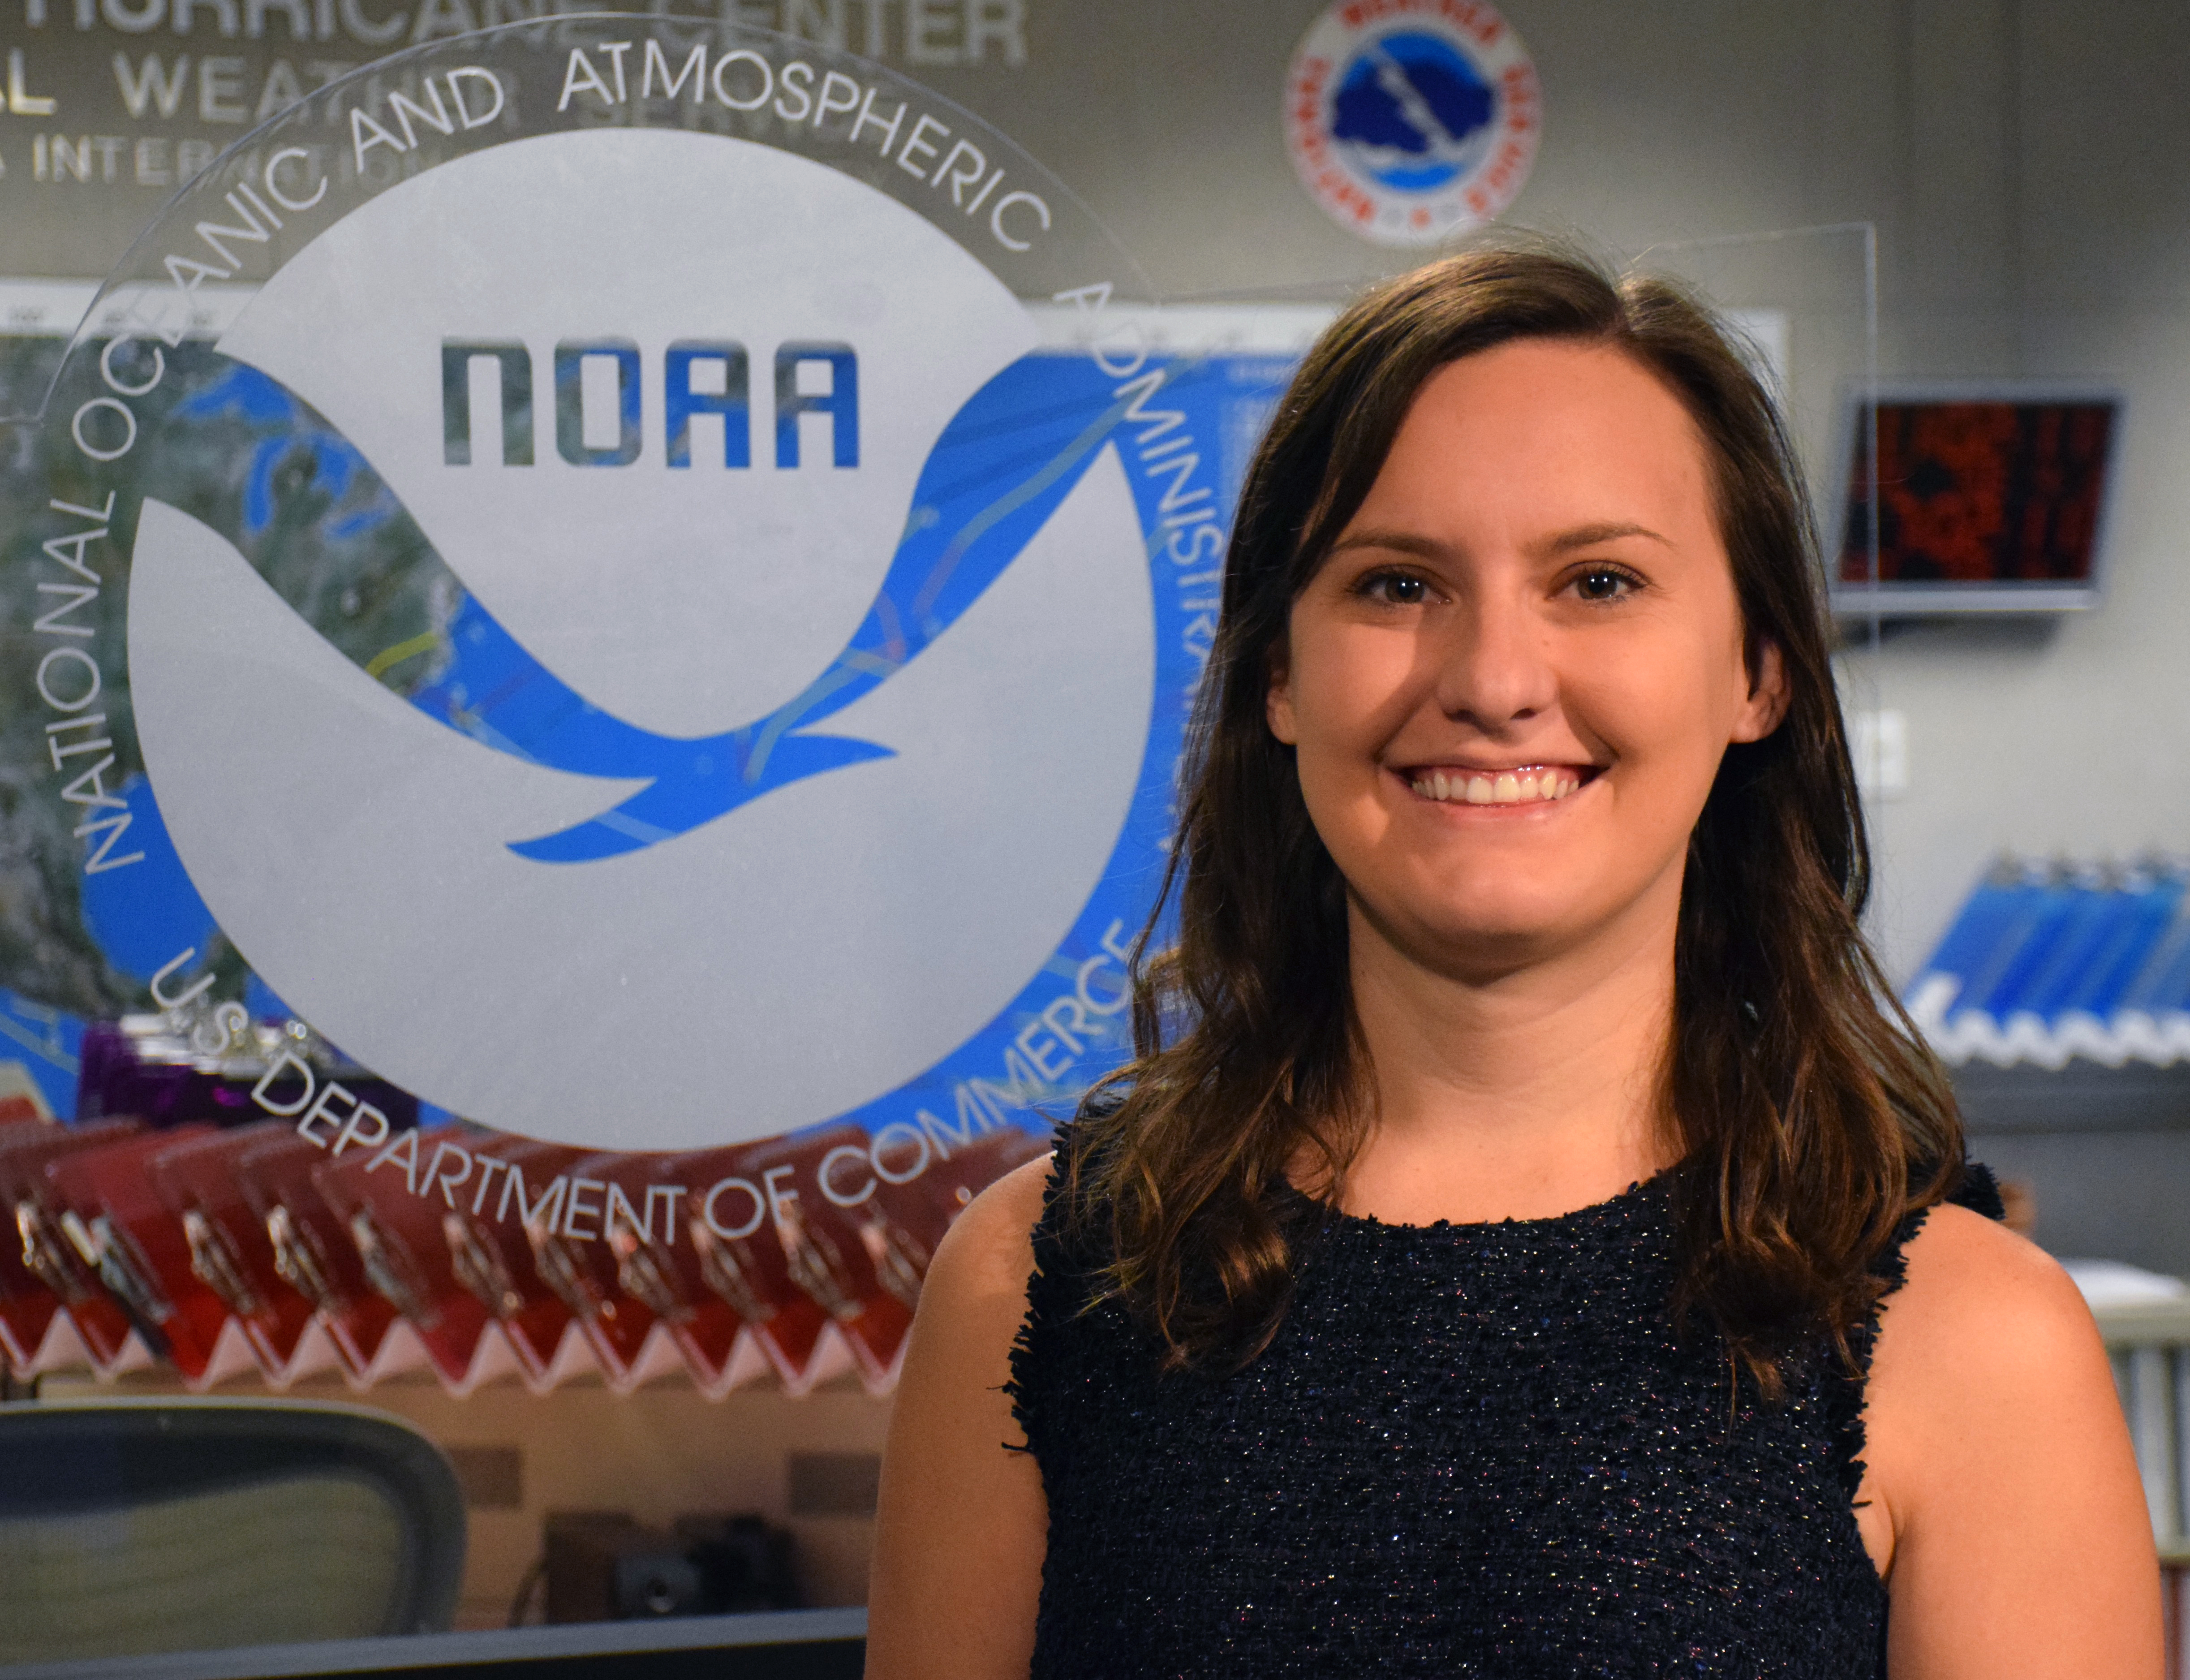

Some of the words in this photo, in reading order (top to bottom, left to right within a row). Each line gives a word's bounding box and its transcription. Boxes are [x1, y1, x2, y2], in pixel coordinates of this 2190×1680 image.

[348, 65, 505, 174] AND
[557, 39, 1051, 251] ATMOSPHERIC
[72, 147, 328, 461] OCEANIC
[441, 336, 860, 470] NOAA
[33, 490, 146, 875] NATIONAL
[252, 1050, 687, 1245] DEPARTMENT
[704, 1166, 799, 1240] OF
[817, 918, 1136, 1207] COMMERCE
